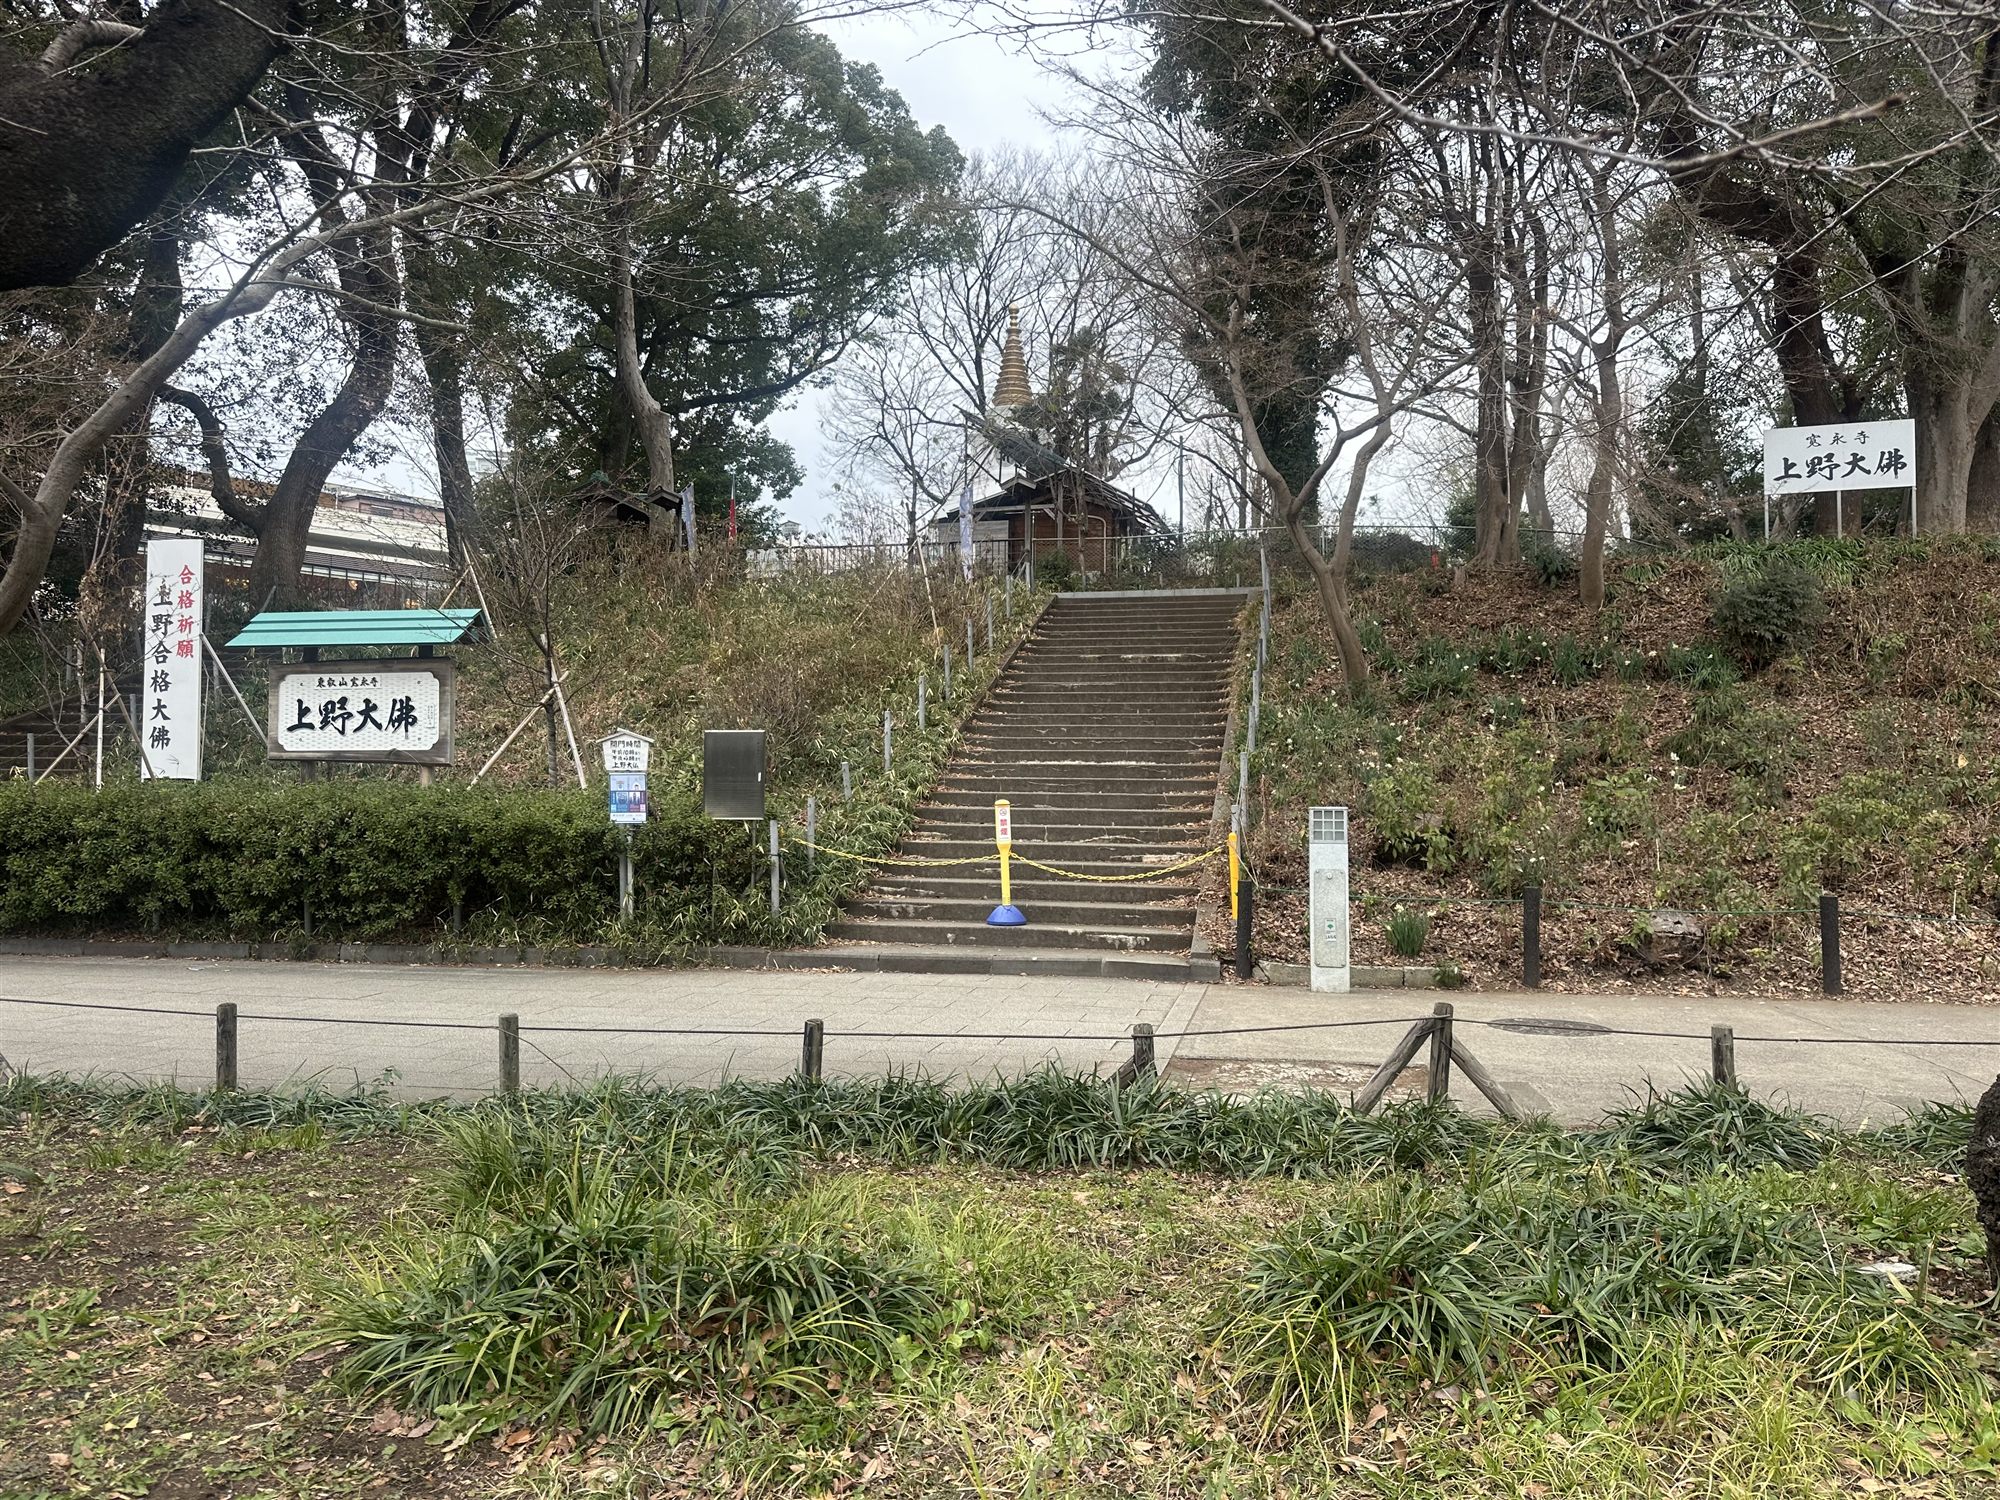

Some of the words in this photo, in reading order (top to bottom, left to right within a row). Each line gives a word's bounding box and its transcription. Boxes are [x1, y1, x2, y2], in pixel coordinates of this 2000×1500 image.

[1773, 448, 1908, 480] 上野大佛
[176, 564, 196, 659] 合格祈願
[149, 577, 173, 750] 上野合格大佛
[286, 695, 418, 738] 上野大佛
